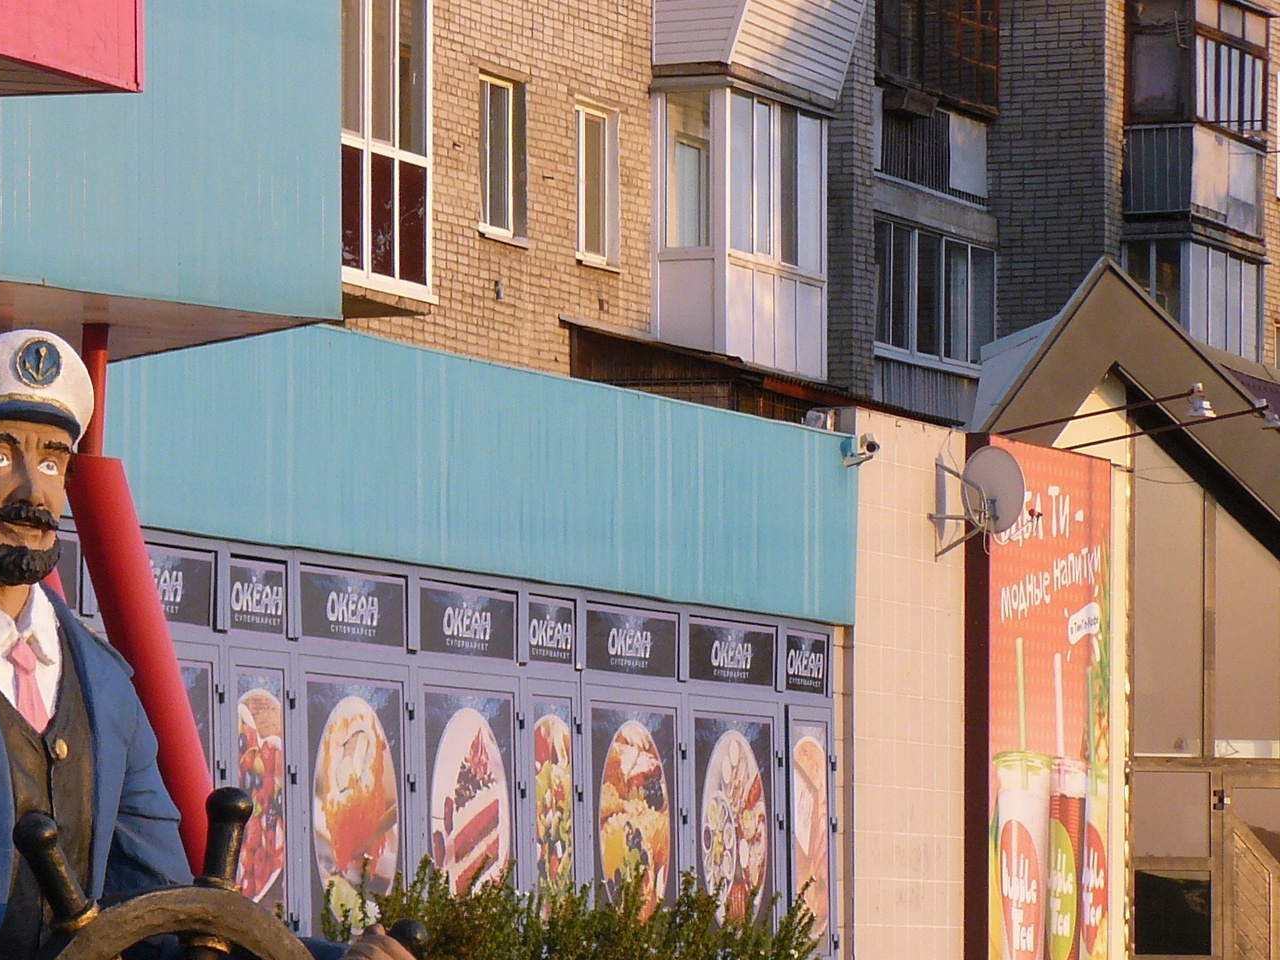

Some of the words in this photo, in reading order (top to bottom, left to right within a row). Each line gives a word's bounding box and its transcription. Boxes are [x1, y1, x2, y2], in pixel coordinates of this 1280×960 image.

[231, 578, 283, 615] ОКЕАН
[327, 588, 379, 626] ОКЕАН
[443, 604, 492, 640] ОКЕАН
[529, 616, 571, 650] ОКЕАН
[608, 625, 652, 659] ОКЕАН
[710, 637, 753, 669] ОКЕАН
[787, 646, 824, 678] ОКЕАН
